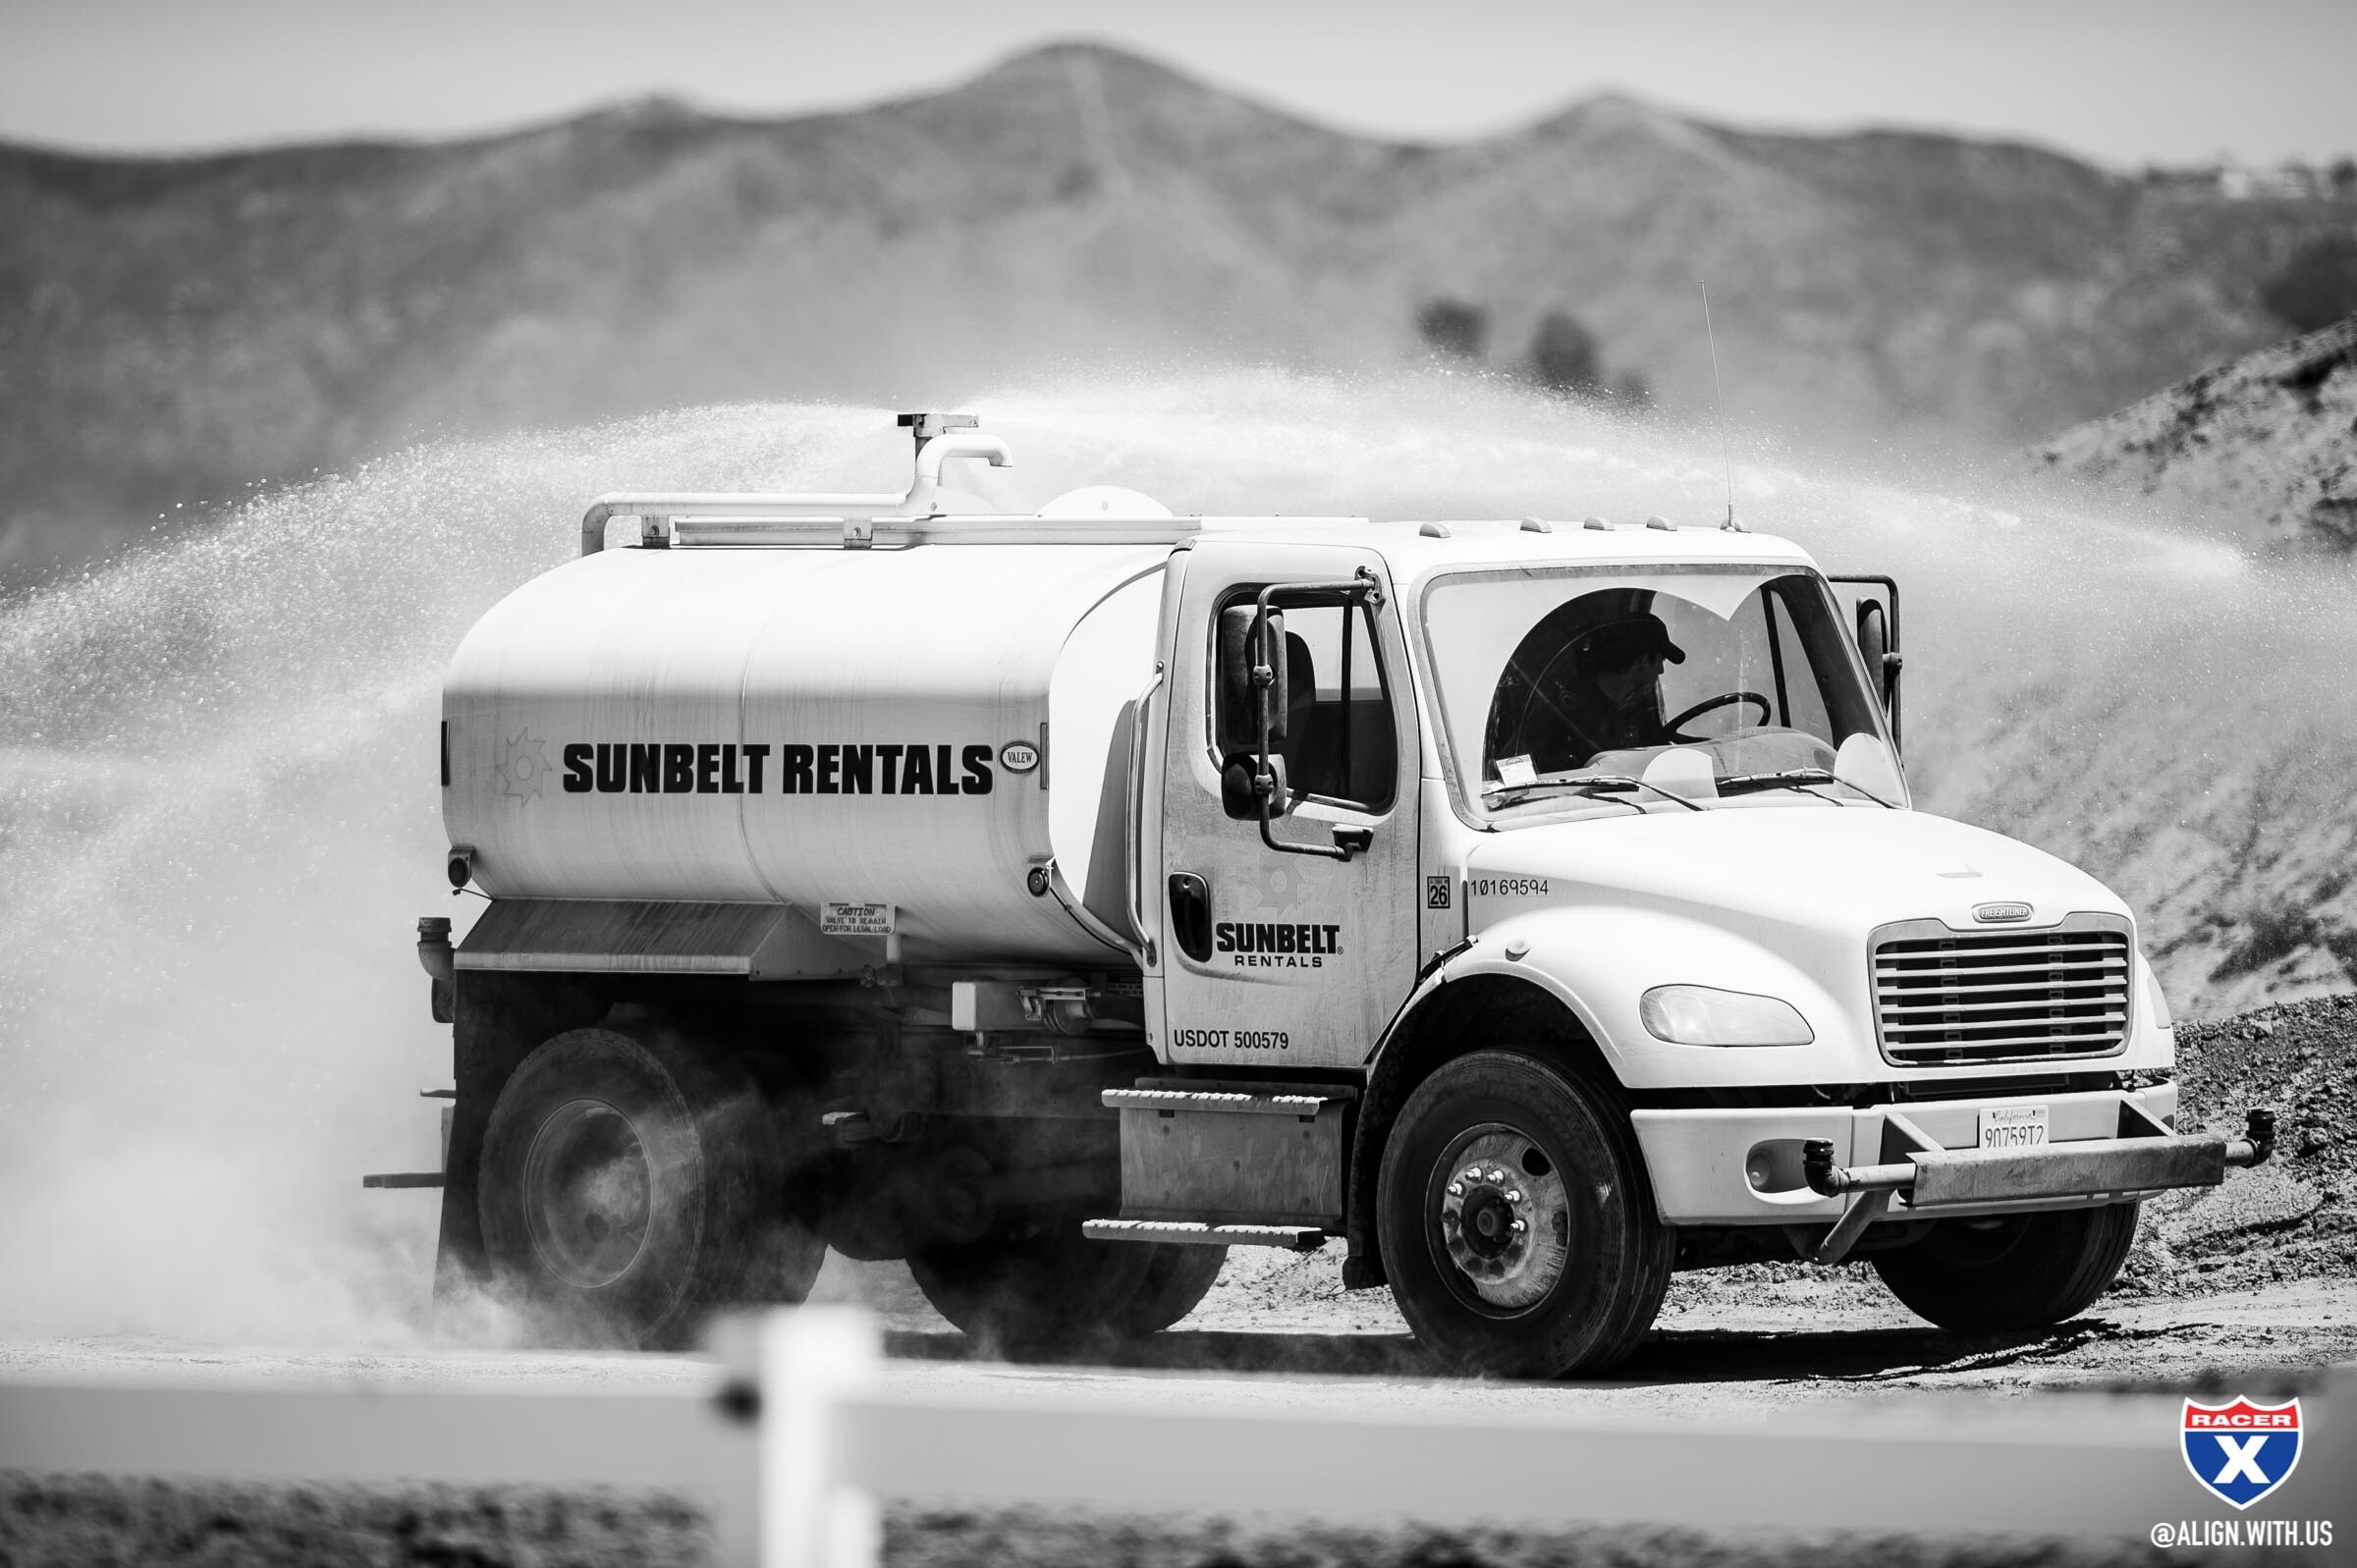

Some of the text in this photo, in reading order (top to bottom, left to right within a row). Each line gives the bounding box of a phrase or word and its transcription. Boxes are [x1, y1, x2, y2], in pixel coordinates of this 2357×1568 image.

[1007, 751, 1032, 764] VALEW
[563, 742, 994, 795] SUNBELT RENTALS
[1470, 879, 1549, 895] 10169594
[1430, 885, 1449, 905] 26
[838, 907, 875, 916] CAUTION
[1981, 907, 2028, 919] FREIGHTLINER
[1234, 955, 1323, 968] RENTALS
[1174, 1029, 1288, 1050] USDOT 500579
